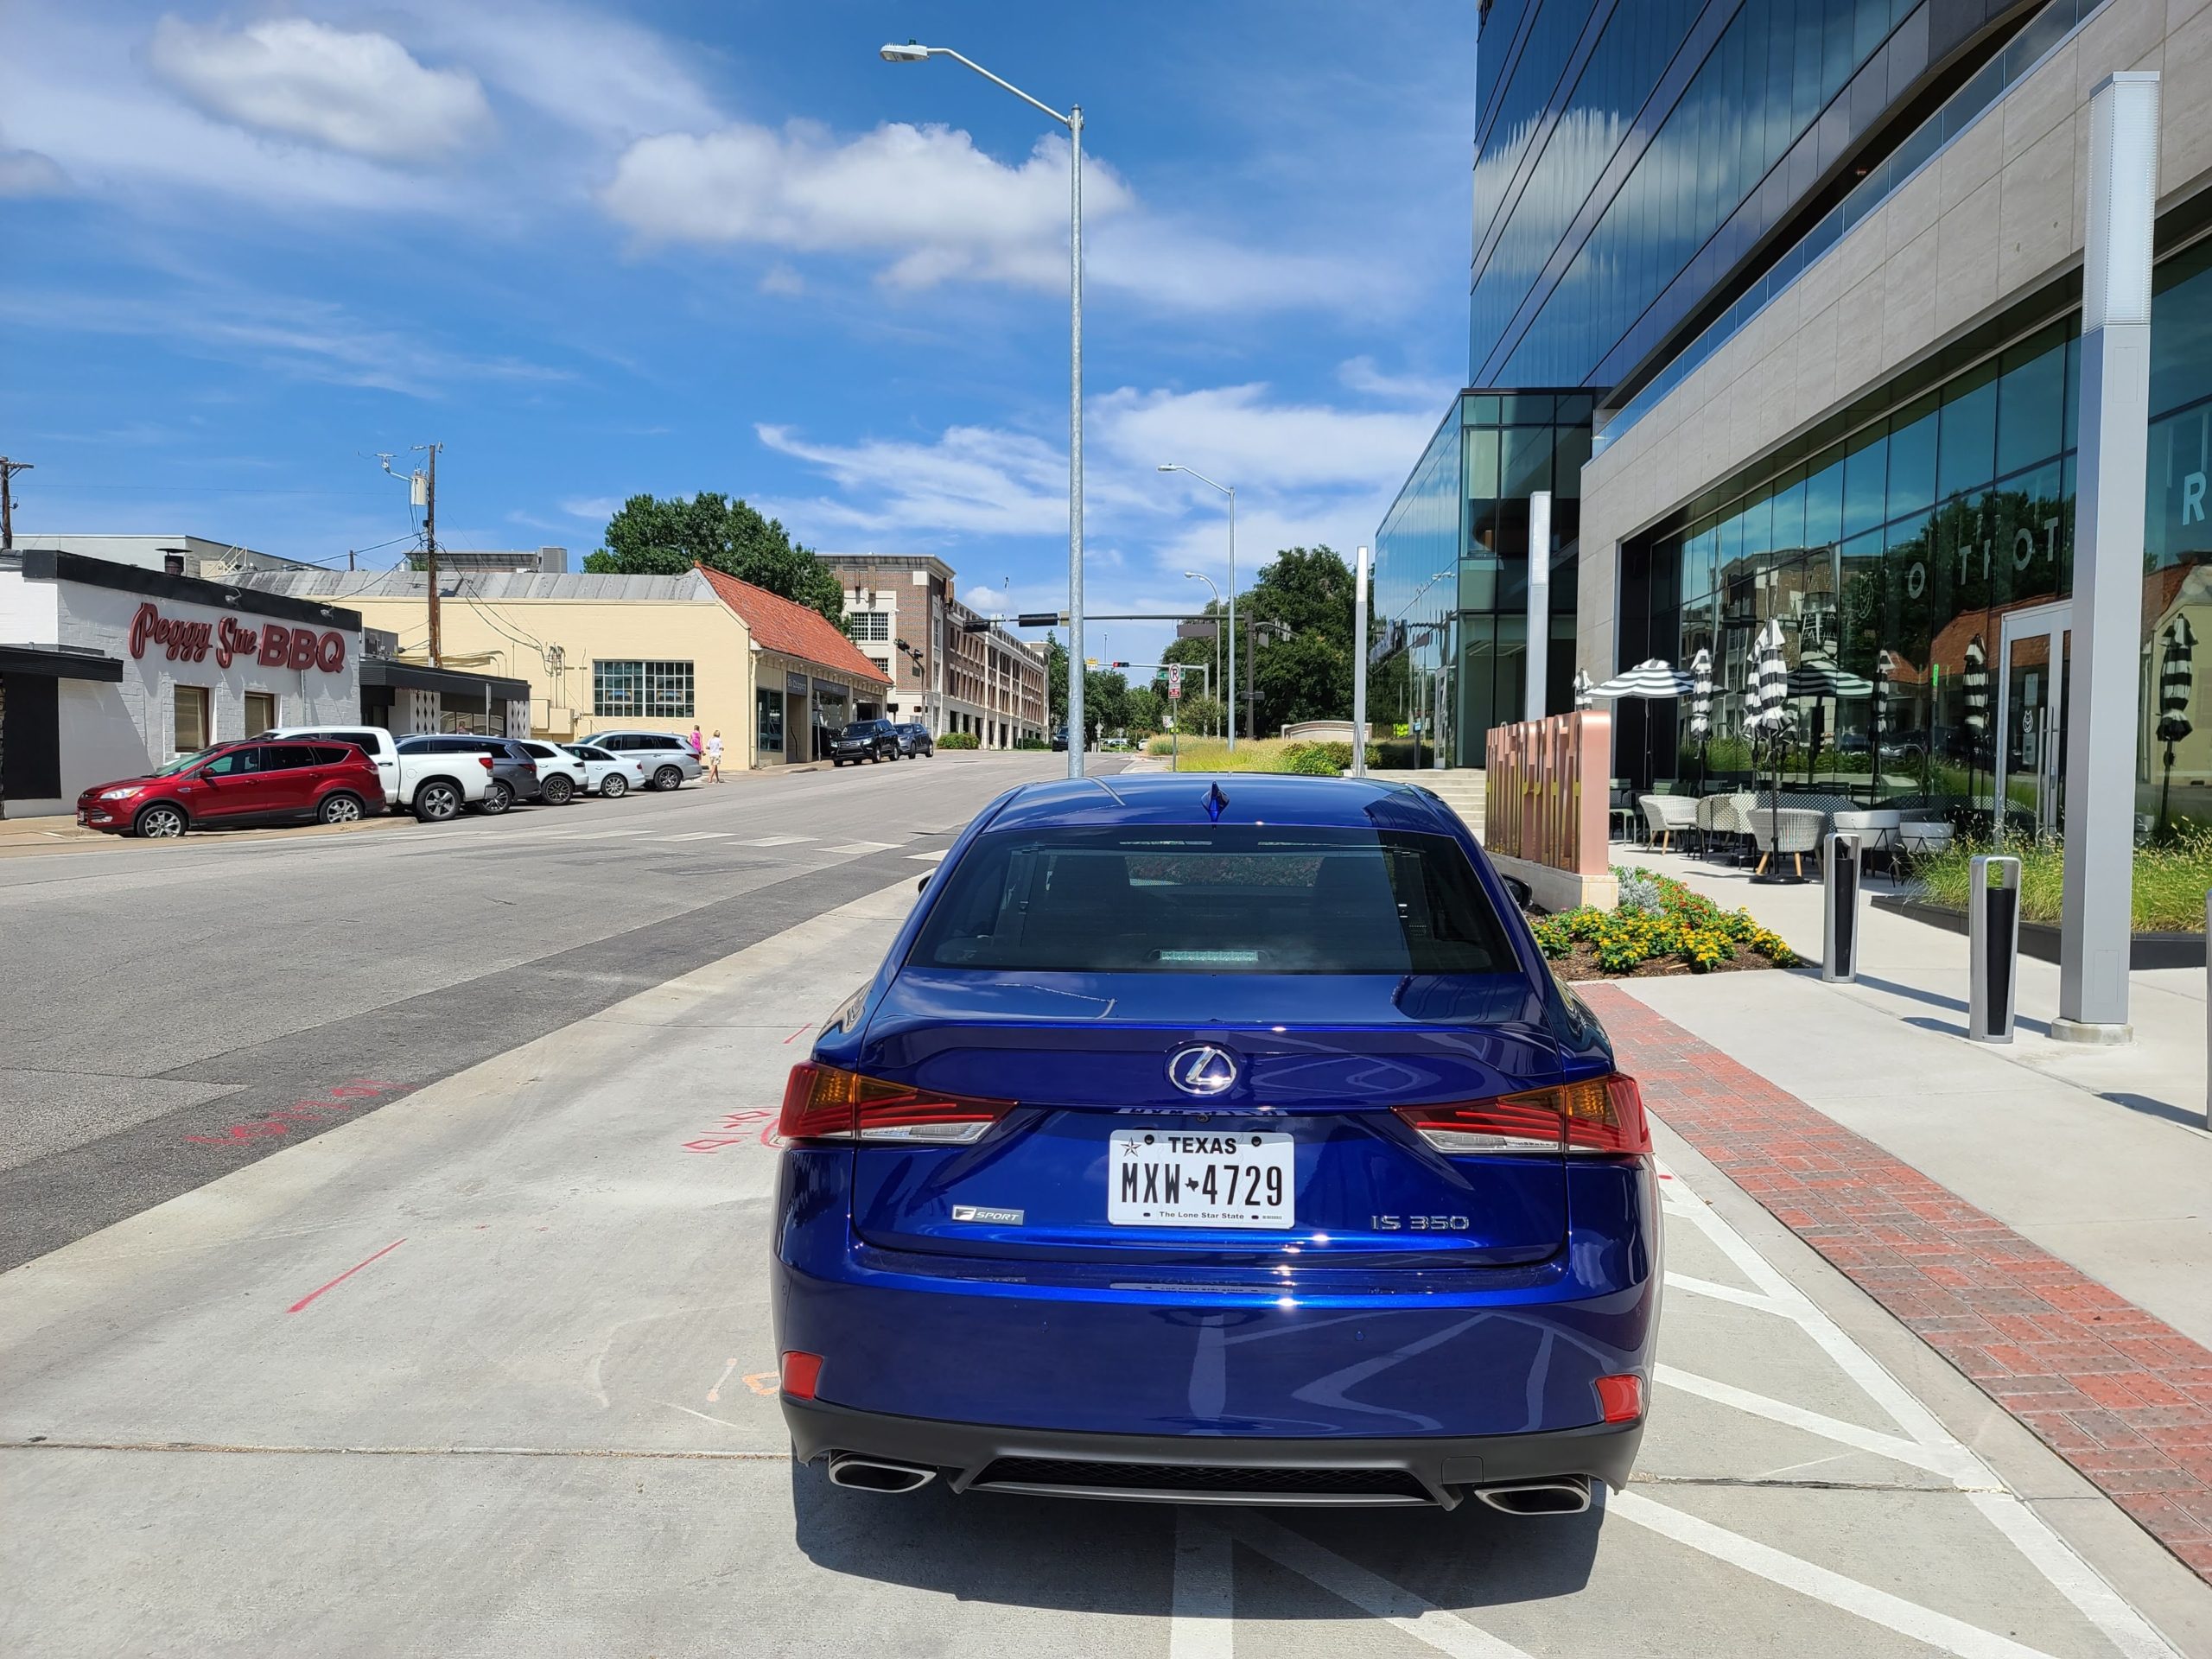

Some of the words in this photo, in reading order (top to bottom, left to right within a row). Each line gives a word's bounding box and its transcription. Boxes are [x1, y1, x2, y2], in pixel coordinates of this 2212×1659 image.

[130, 602, 213, 663] Peggy
[216, 617, 257, 669] Sue
[257, 623, 346, 673] BBQ
[1167, 1136, 1237, 1155] TEXAS
[976, 1211, 1020, 1221] SPORT
[1370, 1215, 1402, 1230] IS
[1409, 1215, 1470, 1230] 350
